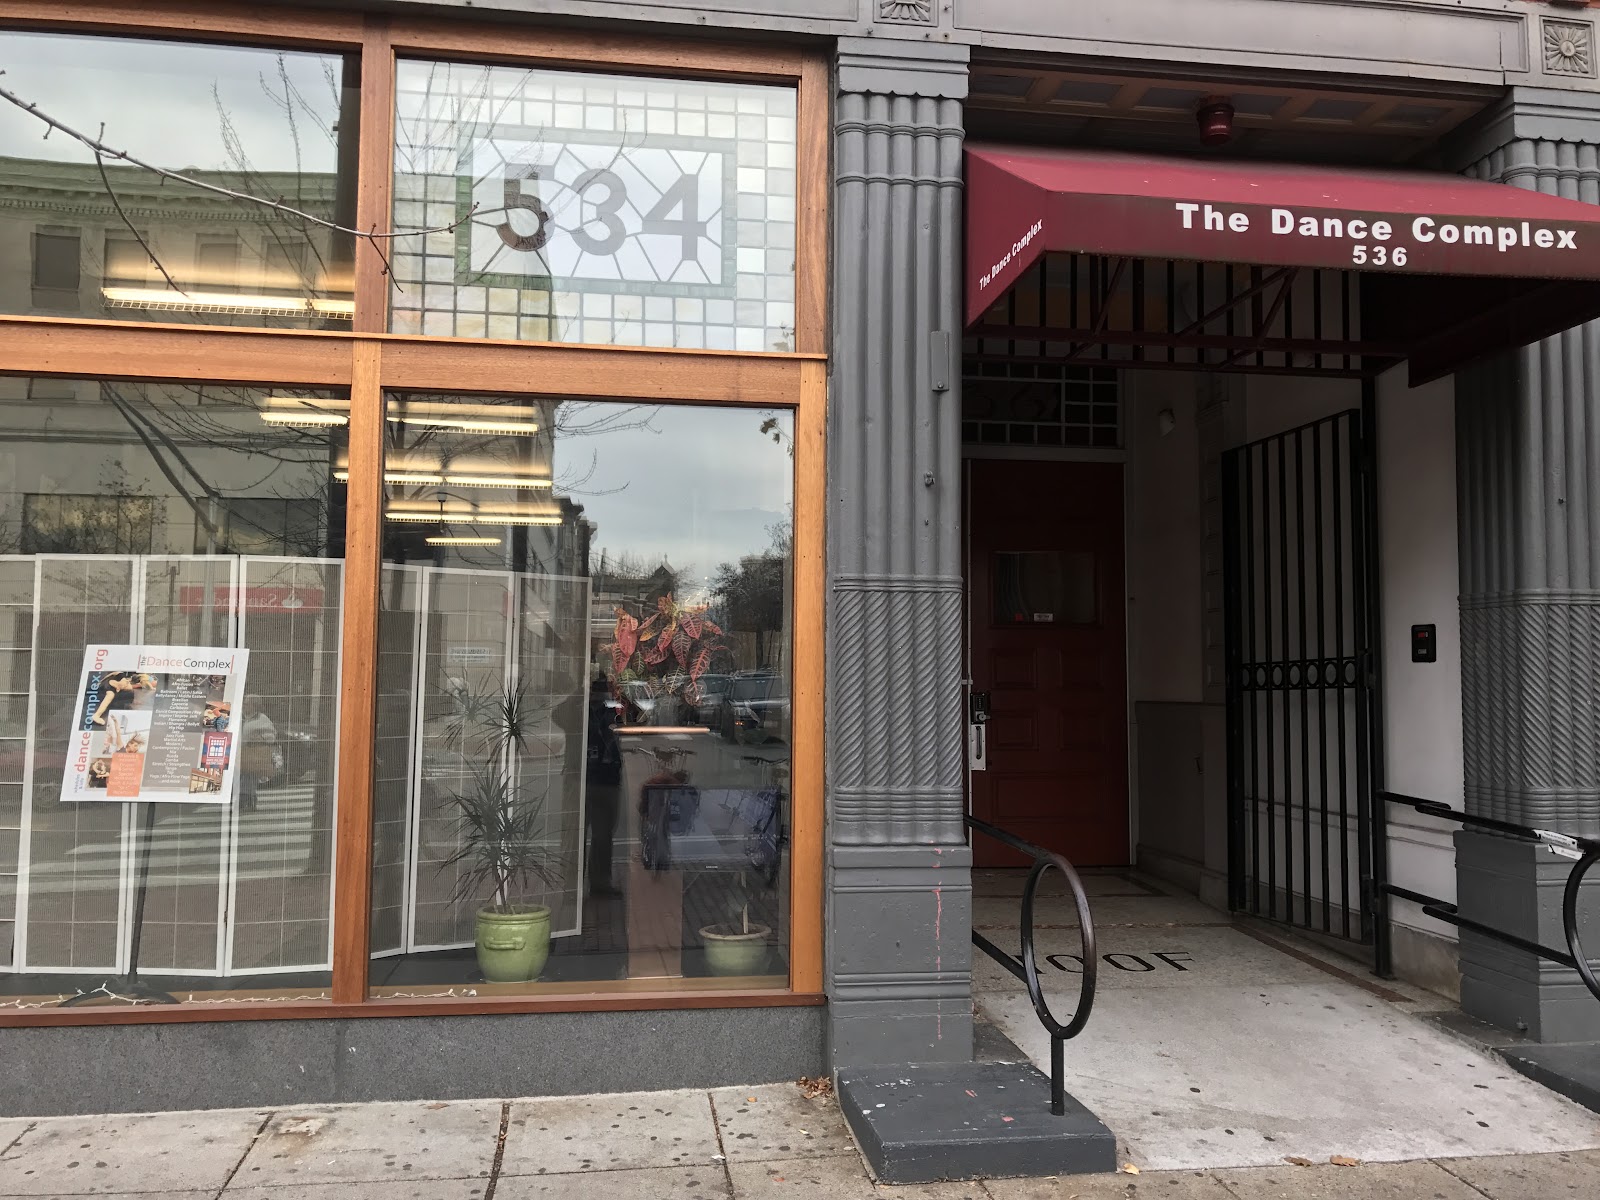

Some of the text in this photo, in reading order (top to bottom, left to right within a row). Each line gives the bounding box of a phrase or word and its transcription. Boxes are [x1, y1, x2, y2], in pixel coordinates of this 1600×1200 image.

[495, 163, 707, 256] 534
[1175, 203, 1579, 251] The Dance Complex
[979, 219, 1043, 290] The Dance Complex
[1352, 244, 1408, 267] 536
